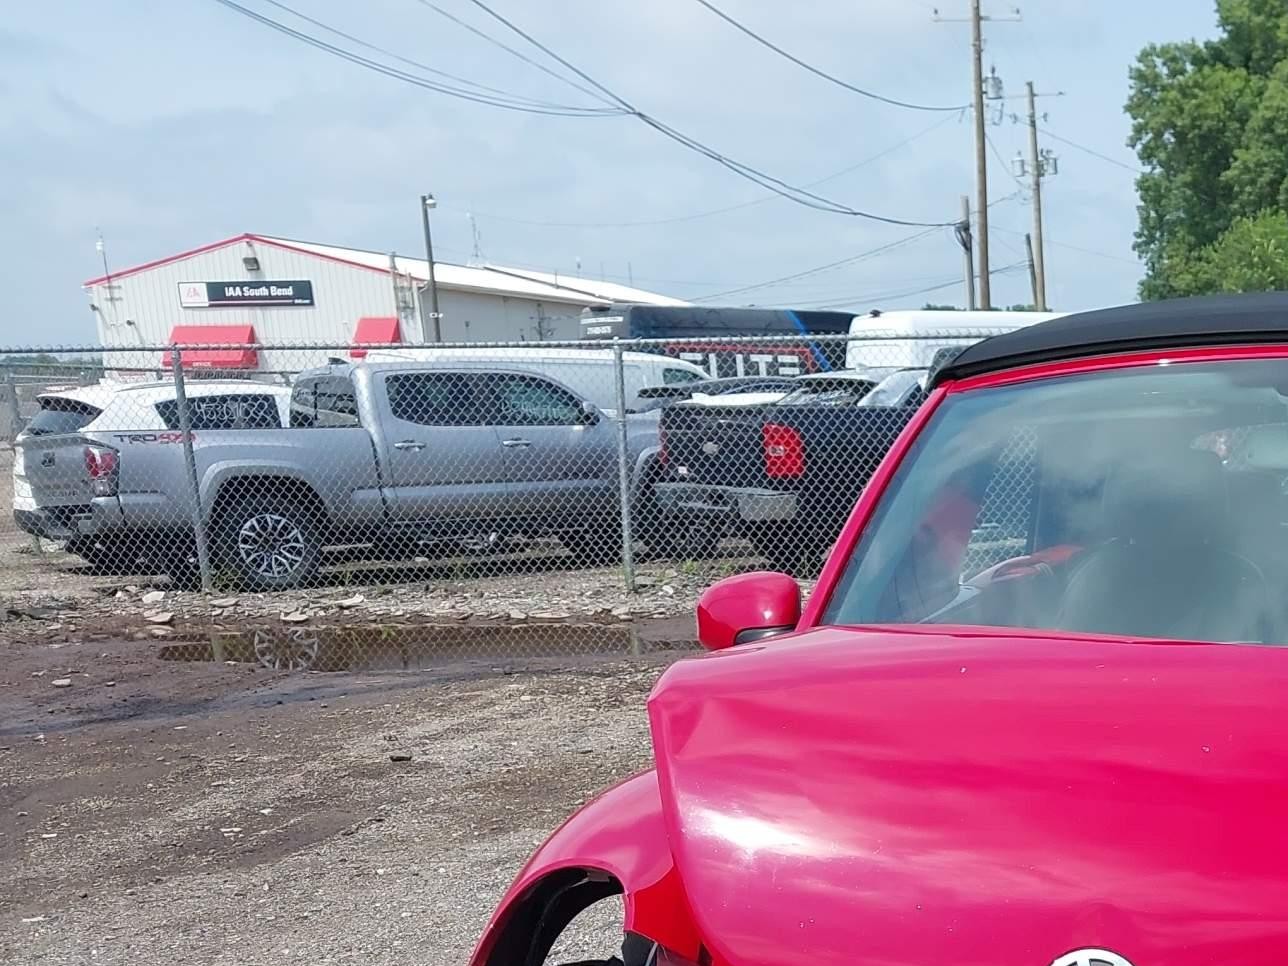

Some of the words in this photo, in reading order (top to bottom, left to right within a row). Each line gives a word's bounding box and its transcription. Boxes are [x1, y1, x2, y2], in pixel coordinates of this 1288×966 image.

[225, 286, 242, 297] IAA
[243, 286, 268, 297] South
[270, 286, 293, 296] Bend
[113, 433, 157, 444] TRD
